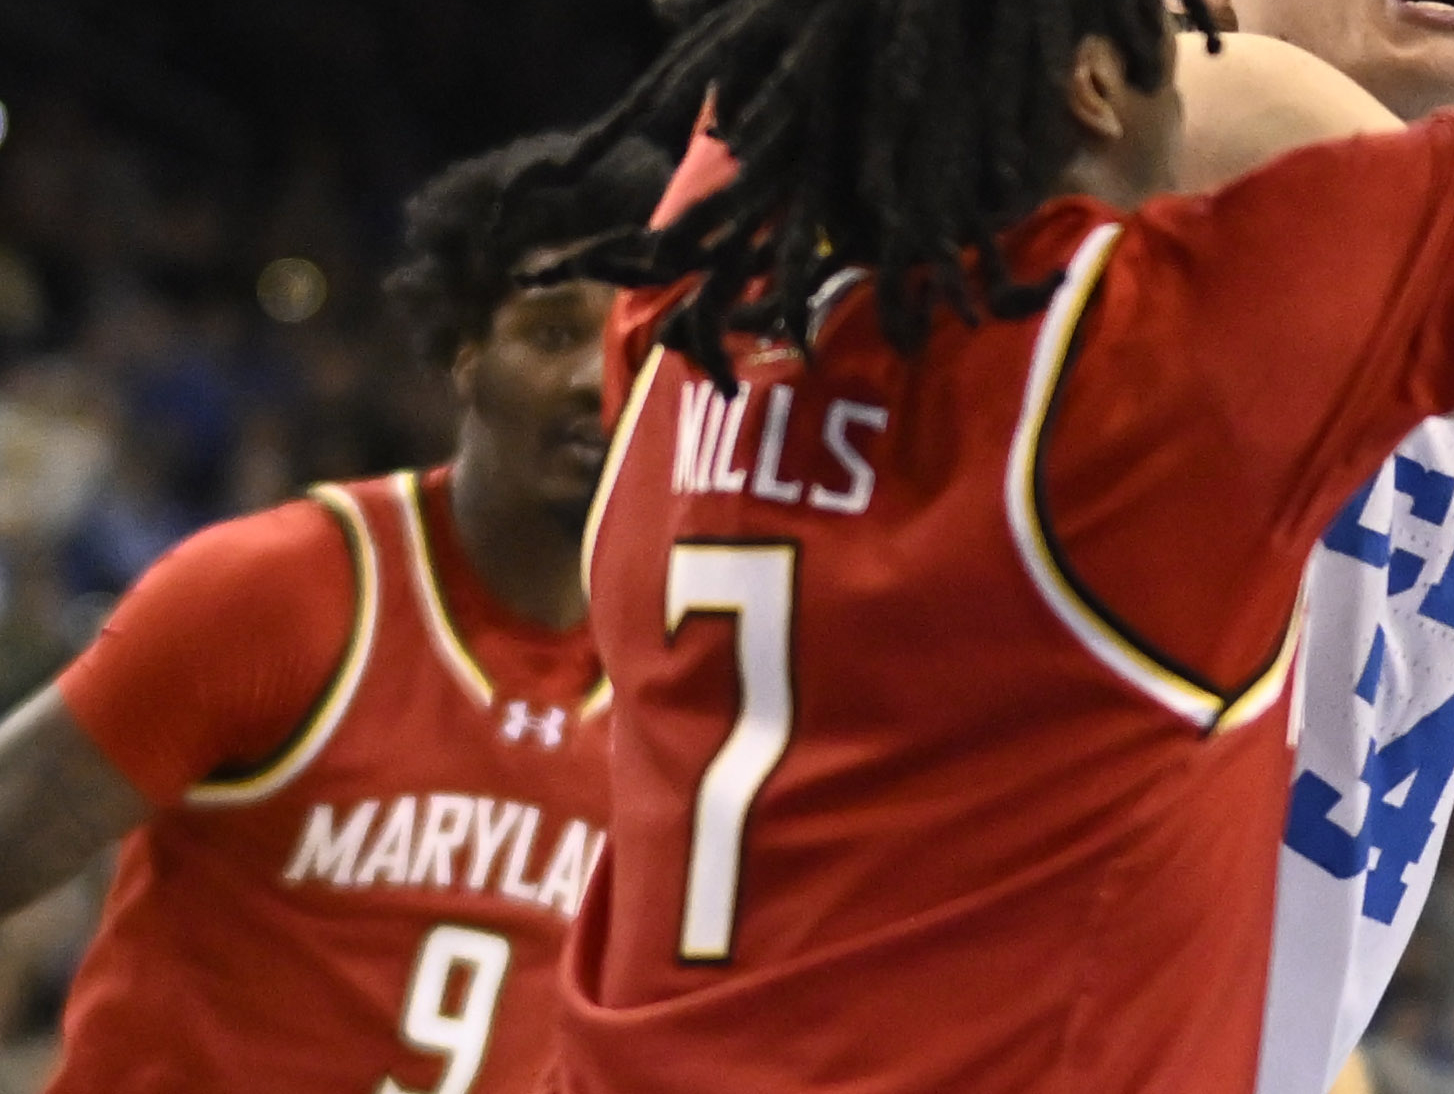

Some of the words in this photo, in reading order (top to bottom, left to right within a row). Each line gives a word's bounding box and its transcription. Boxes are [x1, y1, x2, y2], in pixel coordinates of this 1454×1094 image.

[671, 380, 889, 515] MILLS
[664, 536, 797, 966] 7
[283, 792, 607, 925] MARYLA
[374, 922, 512, 1094] 9
